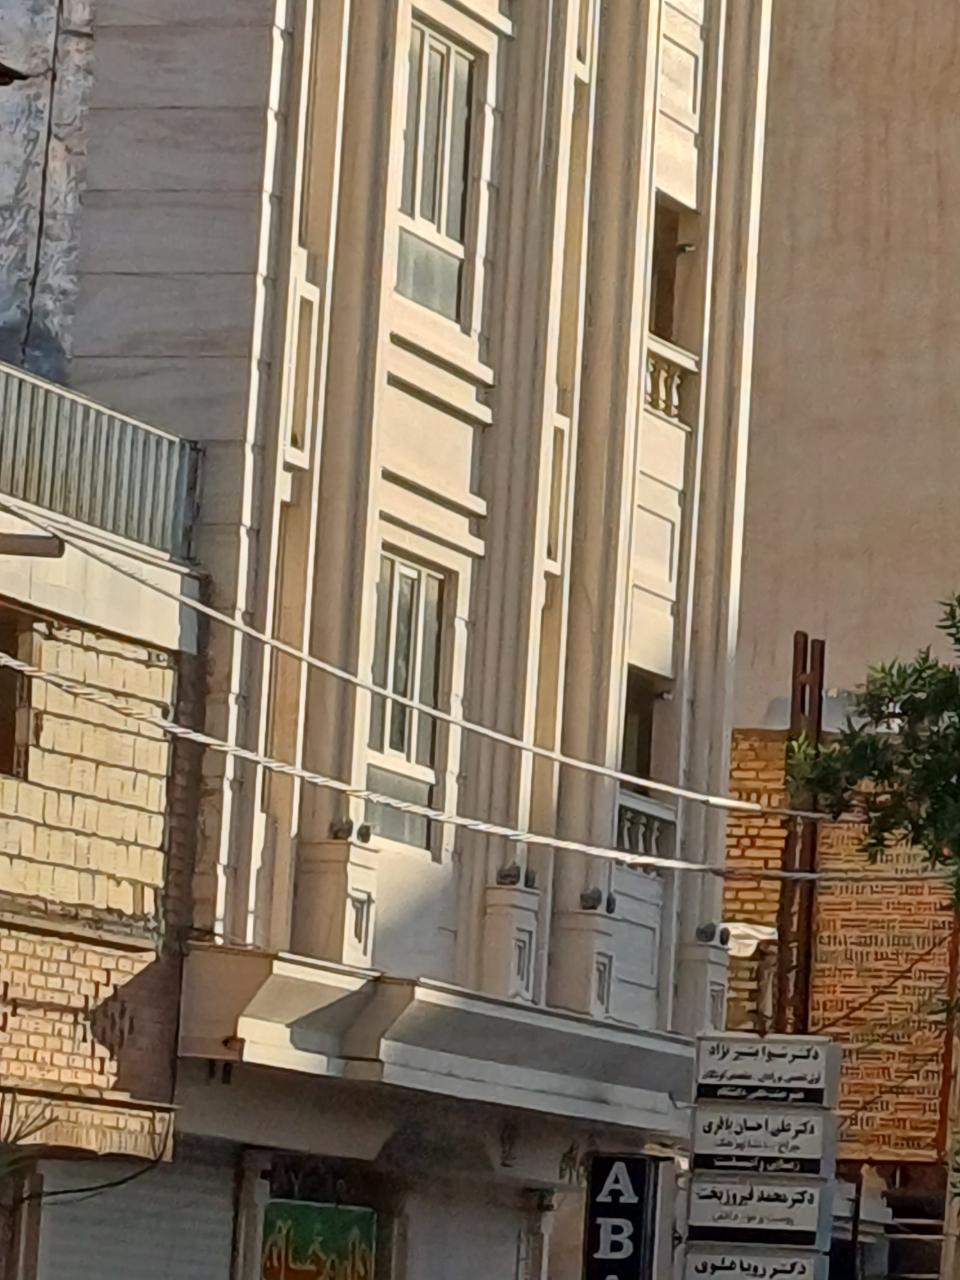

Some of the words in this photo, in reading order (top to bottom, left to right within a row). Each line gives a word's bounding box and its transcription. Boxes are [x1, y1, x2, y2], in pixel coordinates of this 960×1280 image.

[788, 1045, 820, 1064] دکتر
[770, 1118, 792, 1137] علی
[791, 1119, 815, 1140] دکتر
[787, 1189, 815, 1209] دکتر
[592, 1161, 640, 1280] AB
[769, 1260, 807, 1279] دکتر
